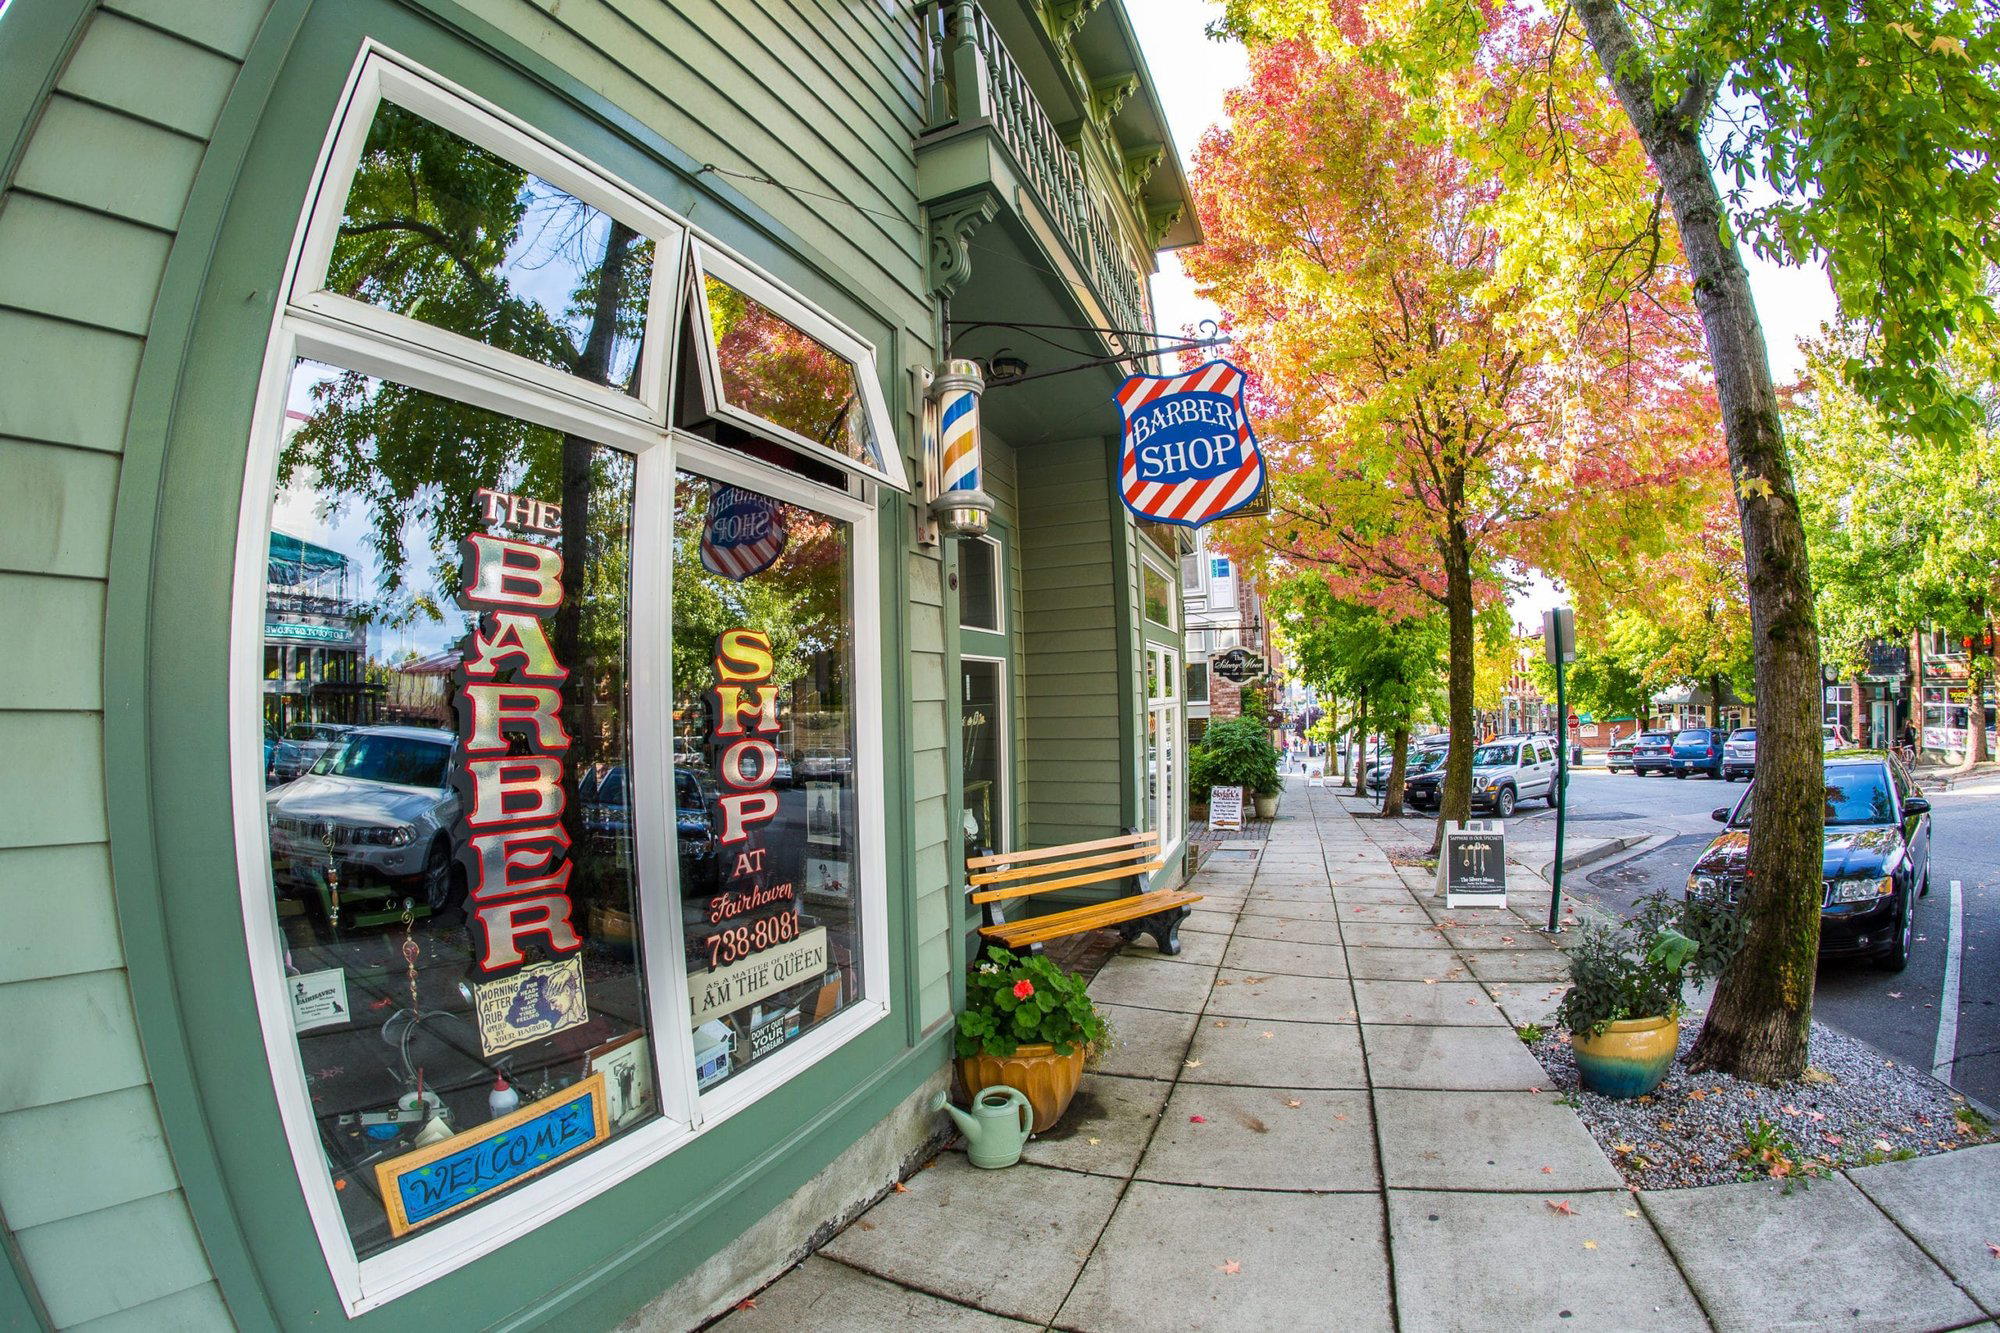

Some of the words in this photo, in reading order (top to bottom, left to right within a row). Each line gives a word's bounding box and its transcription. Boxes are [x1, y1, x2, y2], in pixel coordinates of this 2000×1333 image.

[1133, 398, 1237, 447] BARBER
[1141, 434, 1236, 478] SHOP
[478, 487, 562, 534] THE
[716, 628, 779, 845] SHOP
[464, 532, 583, 972] BARBER
[733, 847, 766, 878] AT
[710, 882, 795, 924] Fairhaven
[689, 996, 695, 1016] I
[702, 983, 732, 1013] AM
[735, 968, 769, 997] THE
[773, 947, 823, 981] QUEEN
[706, 981, 720, 991] AS
[721, 976, 730, 984] A
[732, 962, 769, 981] MATTER
[771, 957, 780, 965] OF
[783, 948, 806, 959] FACT
[481, 983, 519, 1000] MORNING
[483, 996, 512, 1013] AFTER
[484, 1011, 503, 1025] RUB
[516, 1013, 540, 1023] FEELING
[520, 1004, 536, 1012] THAT
[486, 1023, 507, 1033] APPLIED
[494, 1033, 515, 1043] YOUR
[517, 1022, 549, 1037] BARBER
[751, 1025, 770, 1041] DON'T
[770, 1016, 785, 1031] QUIT
[752, 1027, 784, 1049] YOUR
[752, 1036, 785, 1060] DAYDREAMS
[410, 1111, 580, 1205] WELCOME
